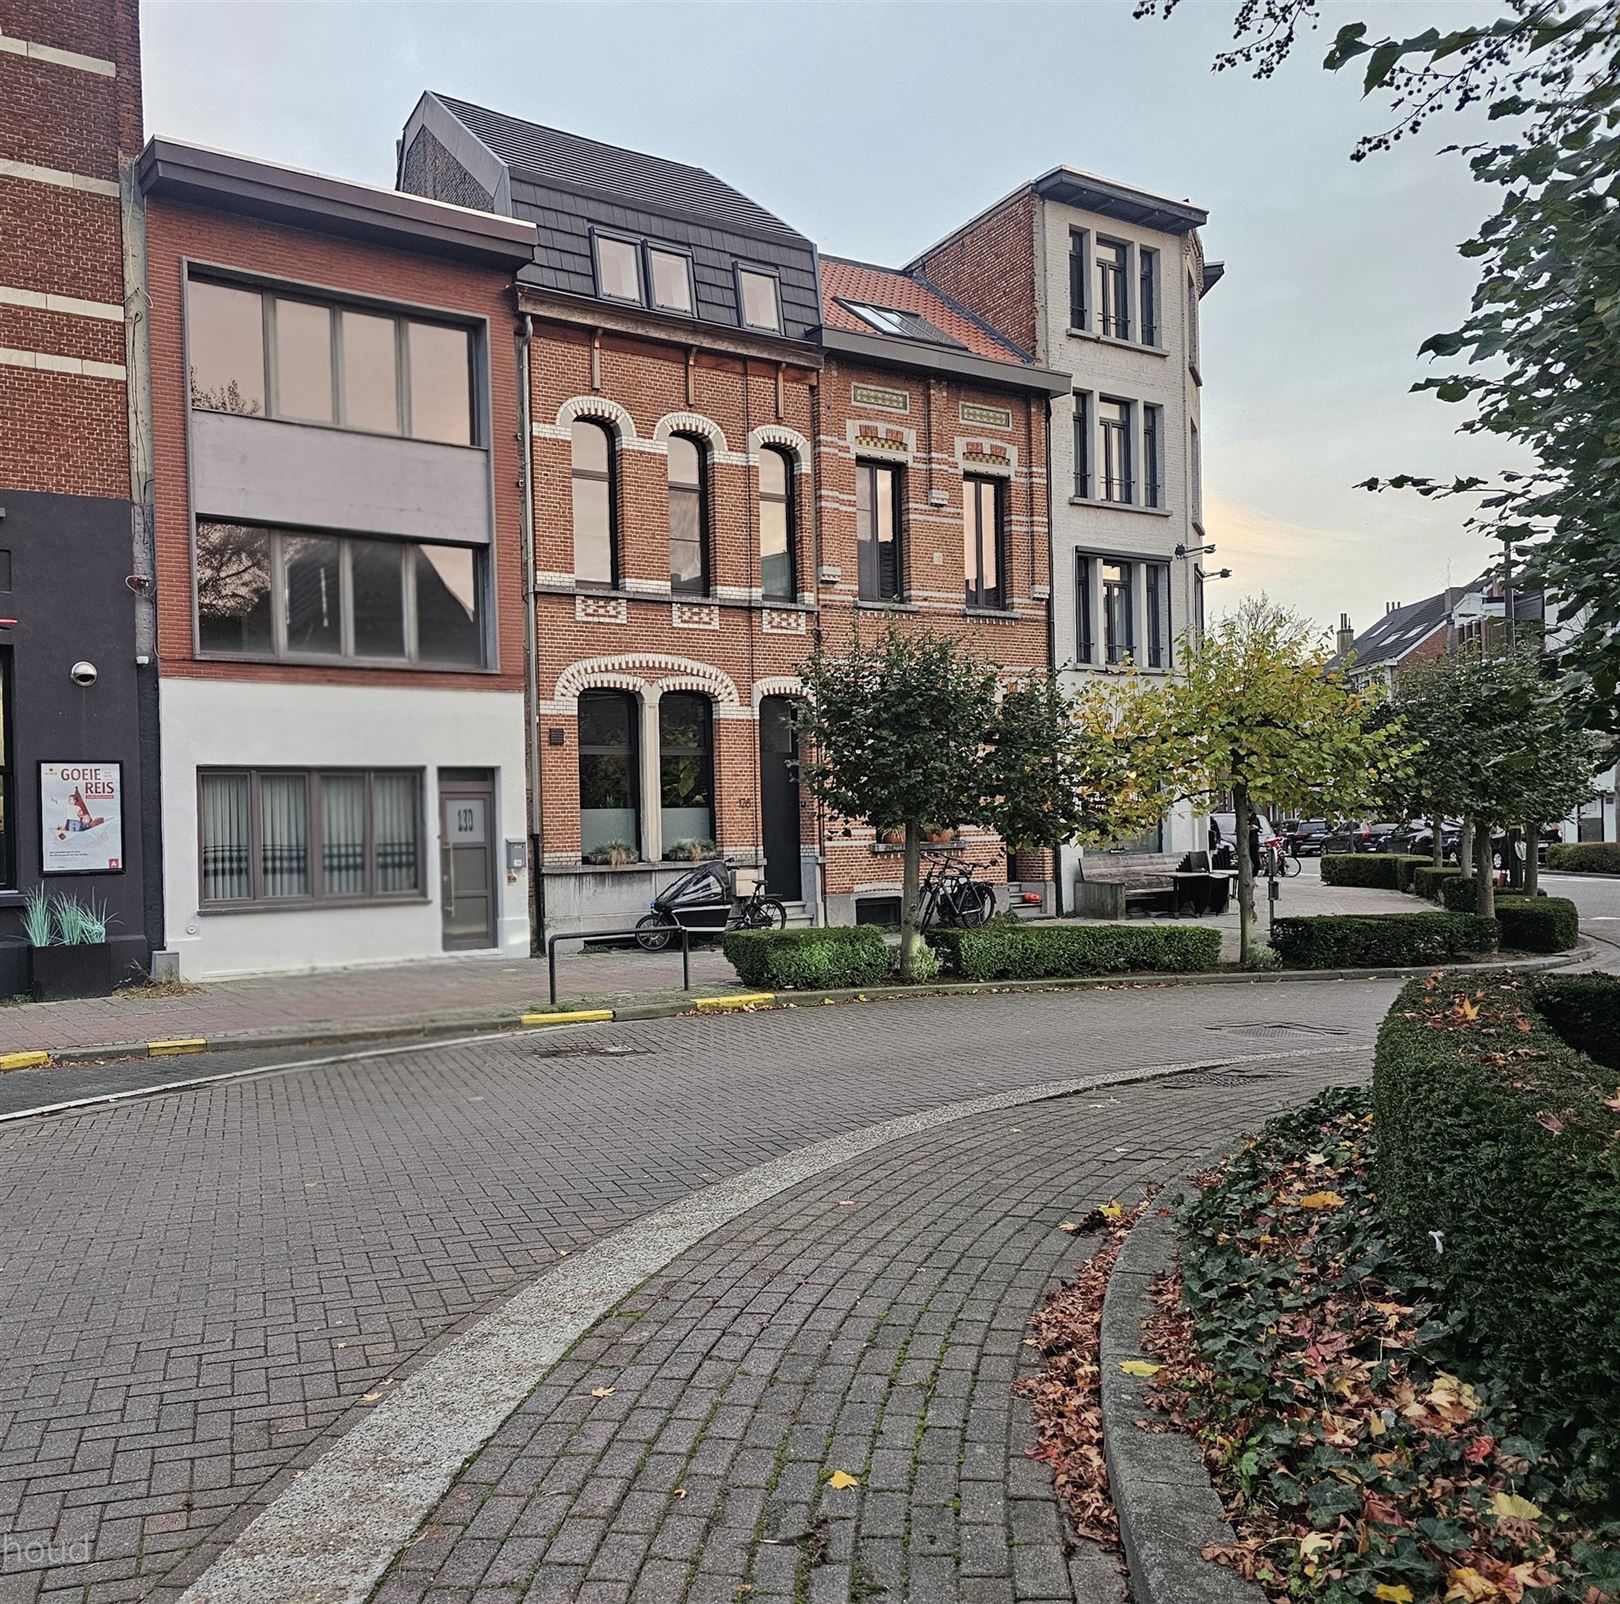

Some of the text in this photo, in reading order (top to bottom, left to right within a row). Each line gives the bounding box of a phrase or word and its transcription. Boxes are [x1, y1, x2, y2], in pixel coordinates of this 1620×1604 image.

[60, 768, 101, 781] GOEIE
[85, 781, 115, 794] REIS
[457, 808, 474, 832] 130
